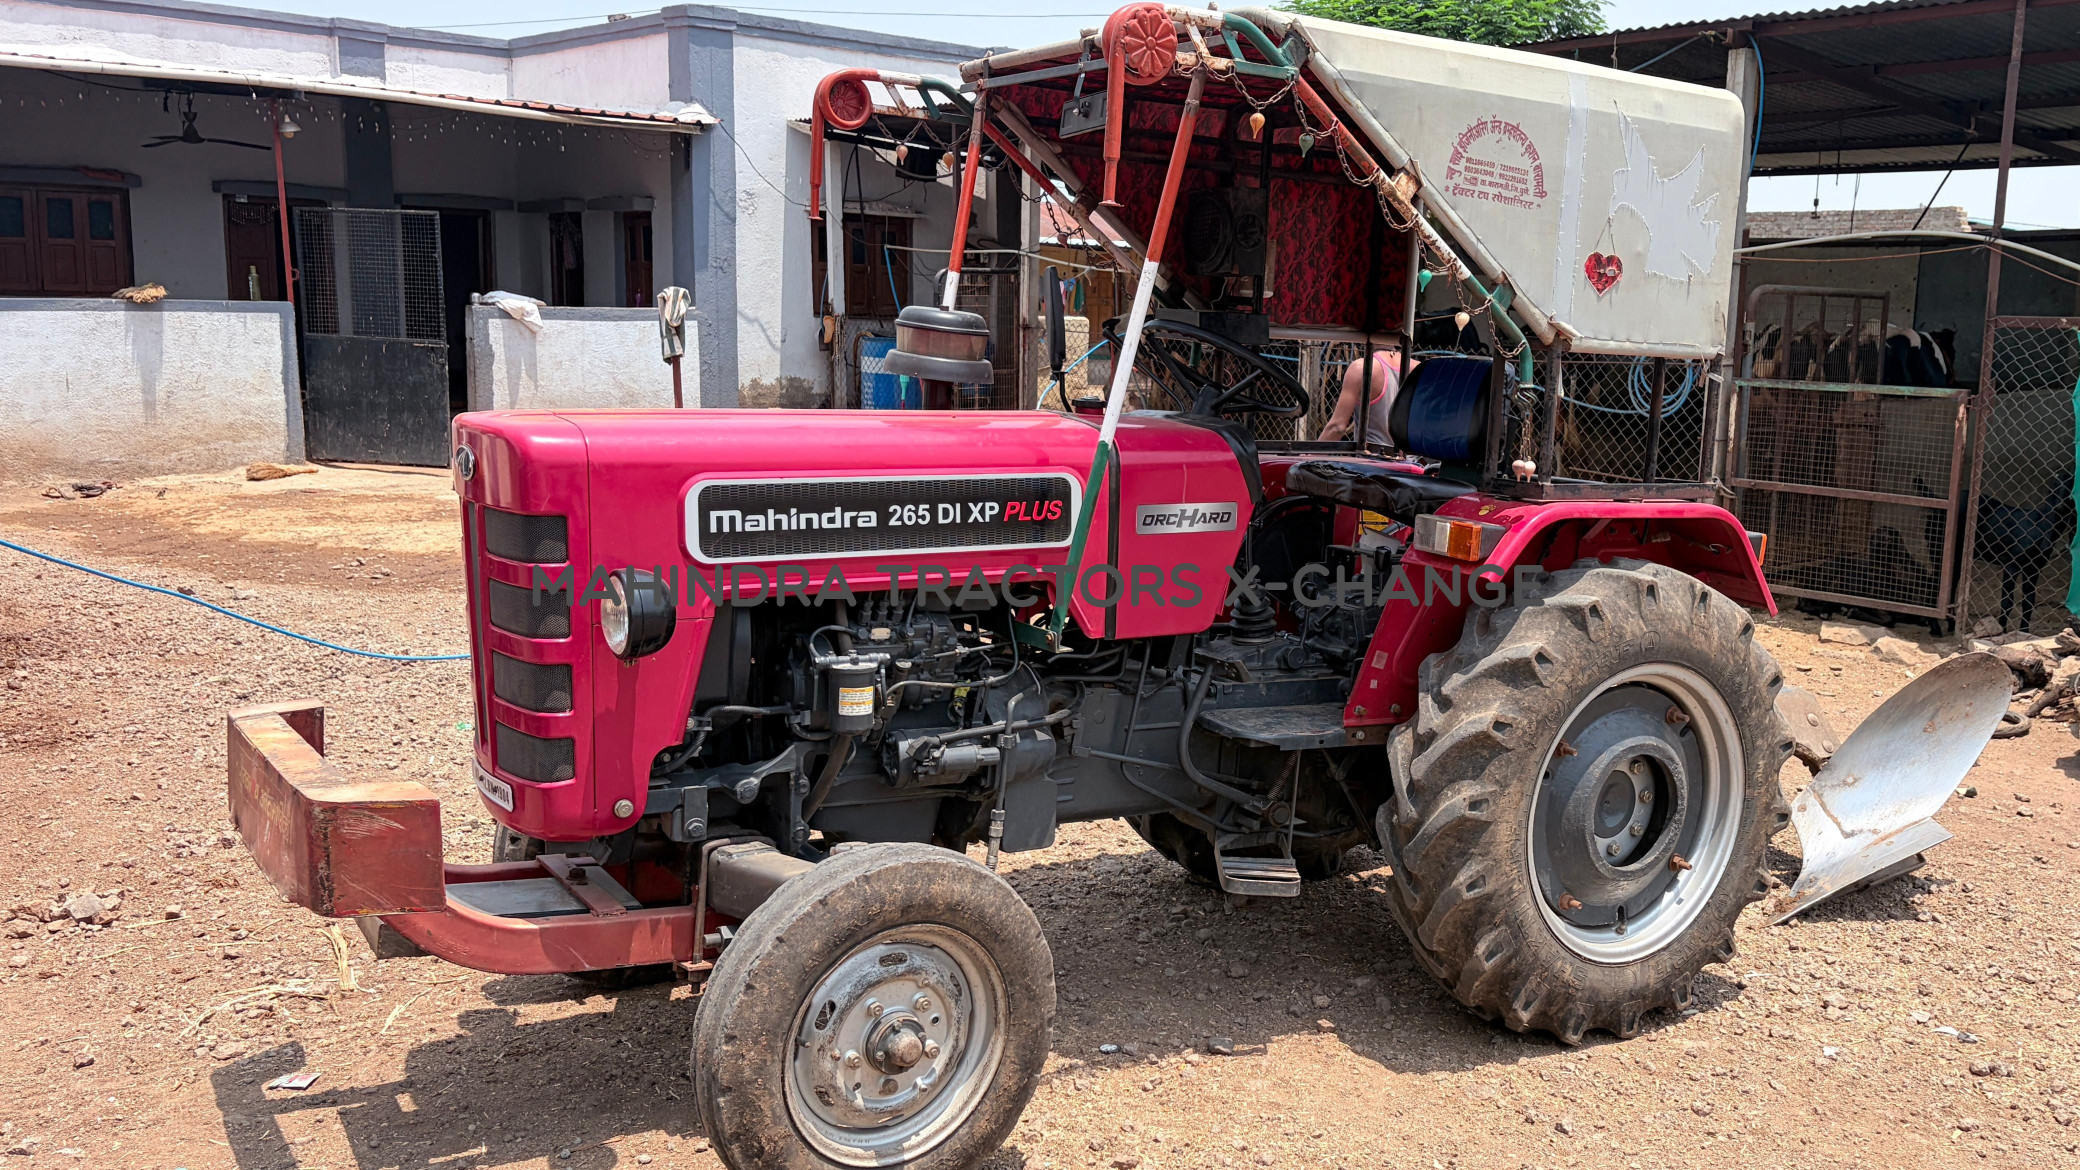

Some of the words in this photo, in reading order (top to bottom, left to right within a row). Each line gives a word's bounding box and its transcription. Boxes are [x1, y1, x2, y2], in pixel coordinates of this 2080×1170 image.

[888, 504, 931, 527] 265
[937, 503, 961, 525] DI
[967, 502, 1000, 524] XP
[1003, 500, 1063, 522] PLUS
